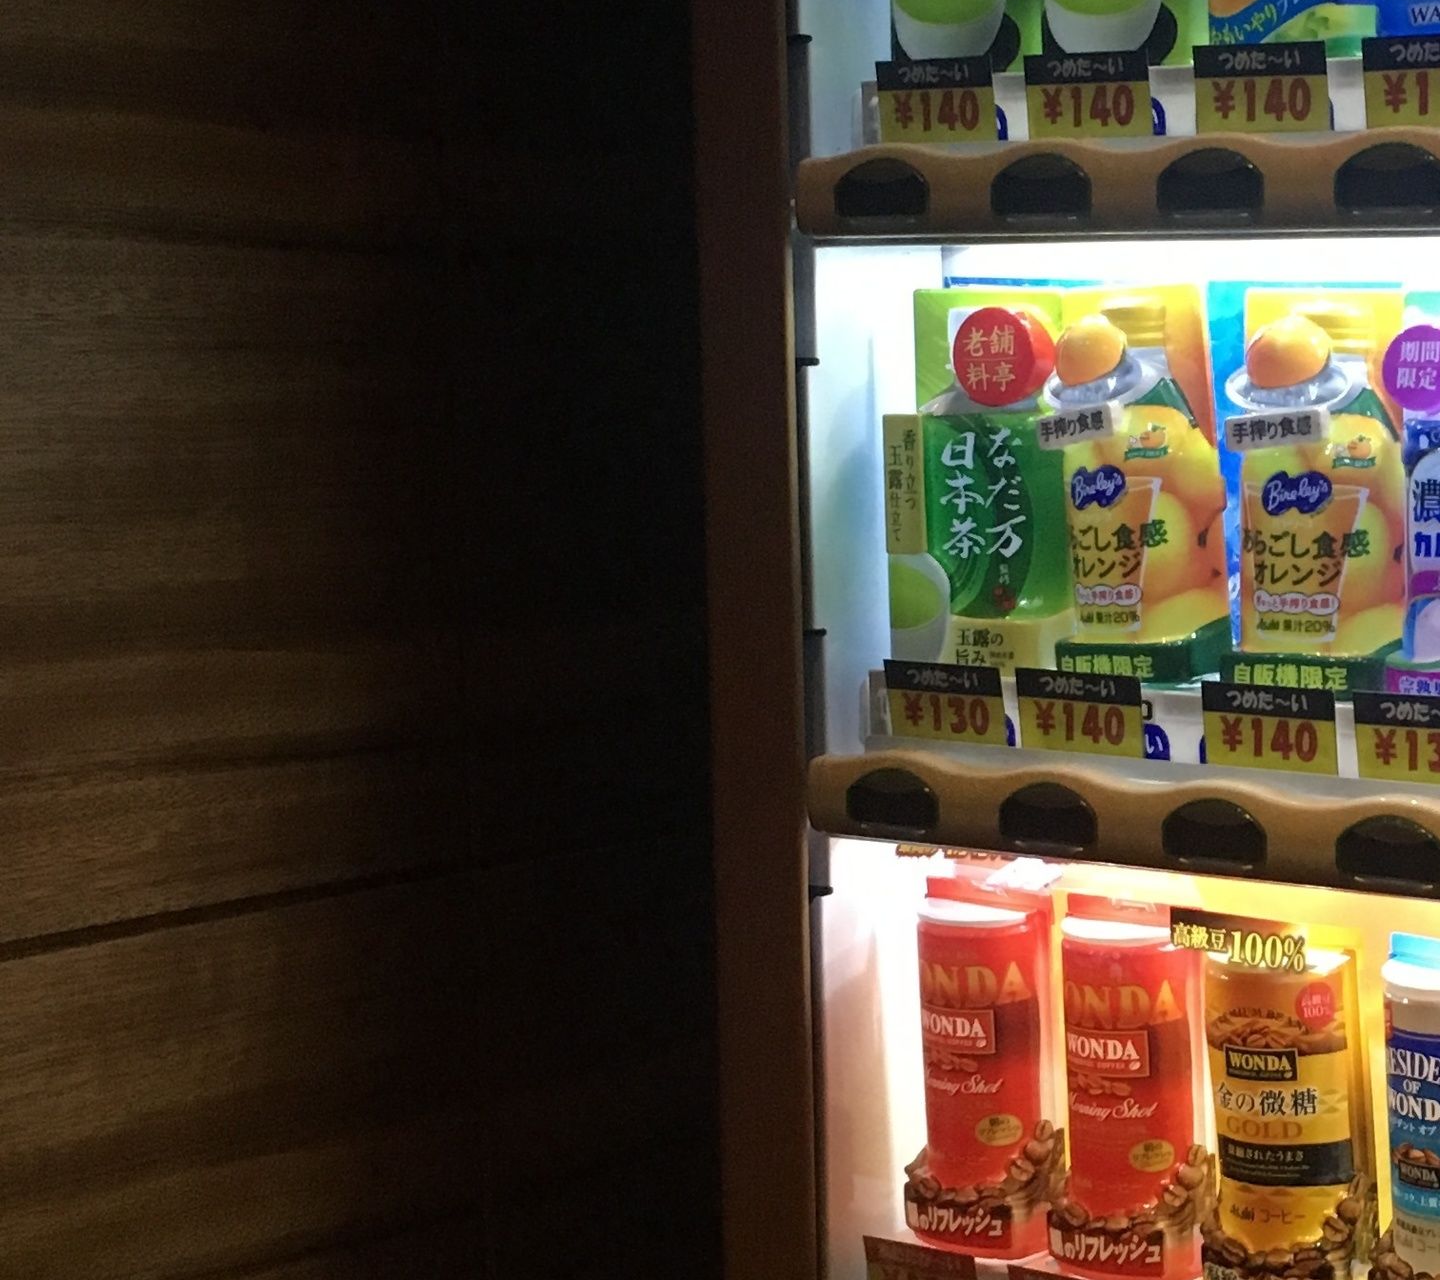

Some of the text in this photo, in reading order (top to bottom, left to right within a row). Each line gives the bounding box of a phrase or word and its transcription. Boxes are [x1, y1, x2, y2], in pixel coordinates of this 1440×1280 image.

[891, 89, 980, 133] ¥140
[1041, 82, 1135, 127] ¥140
[1211, 77, 1312, 122] ¥140
[962, 323, 1015, 359] 老舗
[1399, 340, 1440, 364] 期間
[965, 362, 1016, 393] 料亭
[1396, 367, 1437, 391] 限定
[1232, 416, 1313, 445] 手搾り食感
[903, 429, 917, 511] 香り立つ
[887, 444, 903, 542] 玉露仕立て
[940, 431, 986, 558] 日本茶
[985, 426, 1027, 558] なだ万
[1254, 562, 1342, 587] オレンジ
[956, 628, 1005, 648] 玉露の
[903, 691, 990, 737] ¥130
[1032, 699, 1125, 746] ¥140
[1219, 716, 1318, 763] ¥140
[1228, 1051, 1292, 1071] WONDA
[1216, 1081, 1318, 1116] 金の微糖
[1402, 1078, 1422, 1095] OF
[1226, 1116, 1304, 1139] GOLD
[1258, 1208, 1307, 1226] コーヒー
